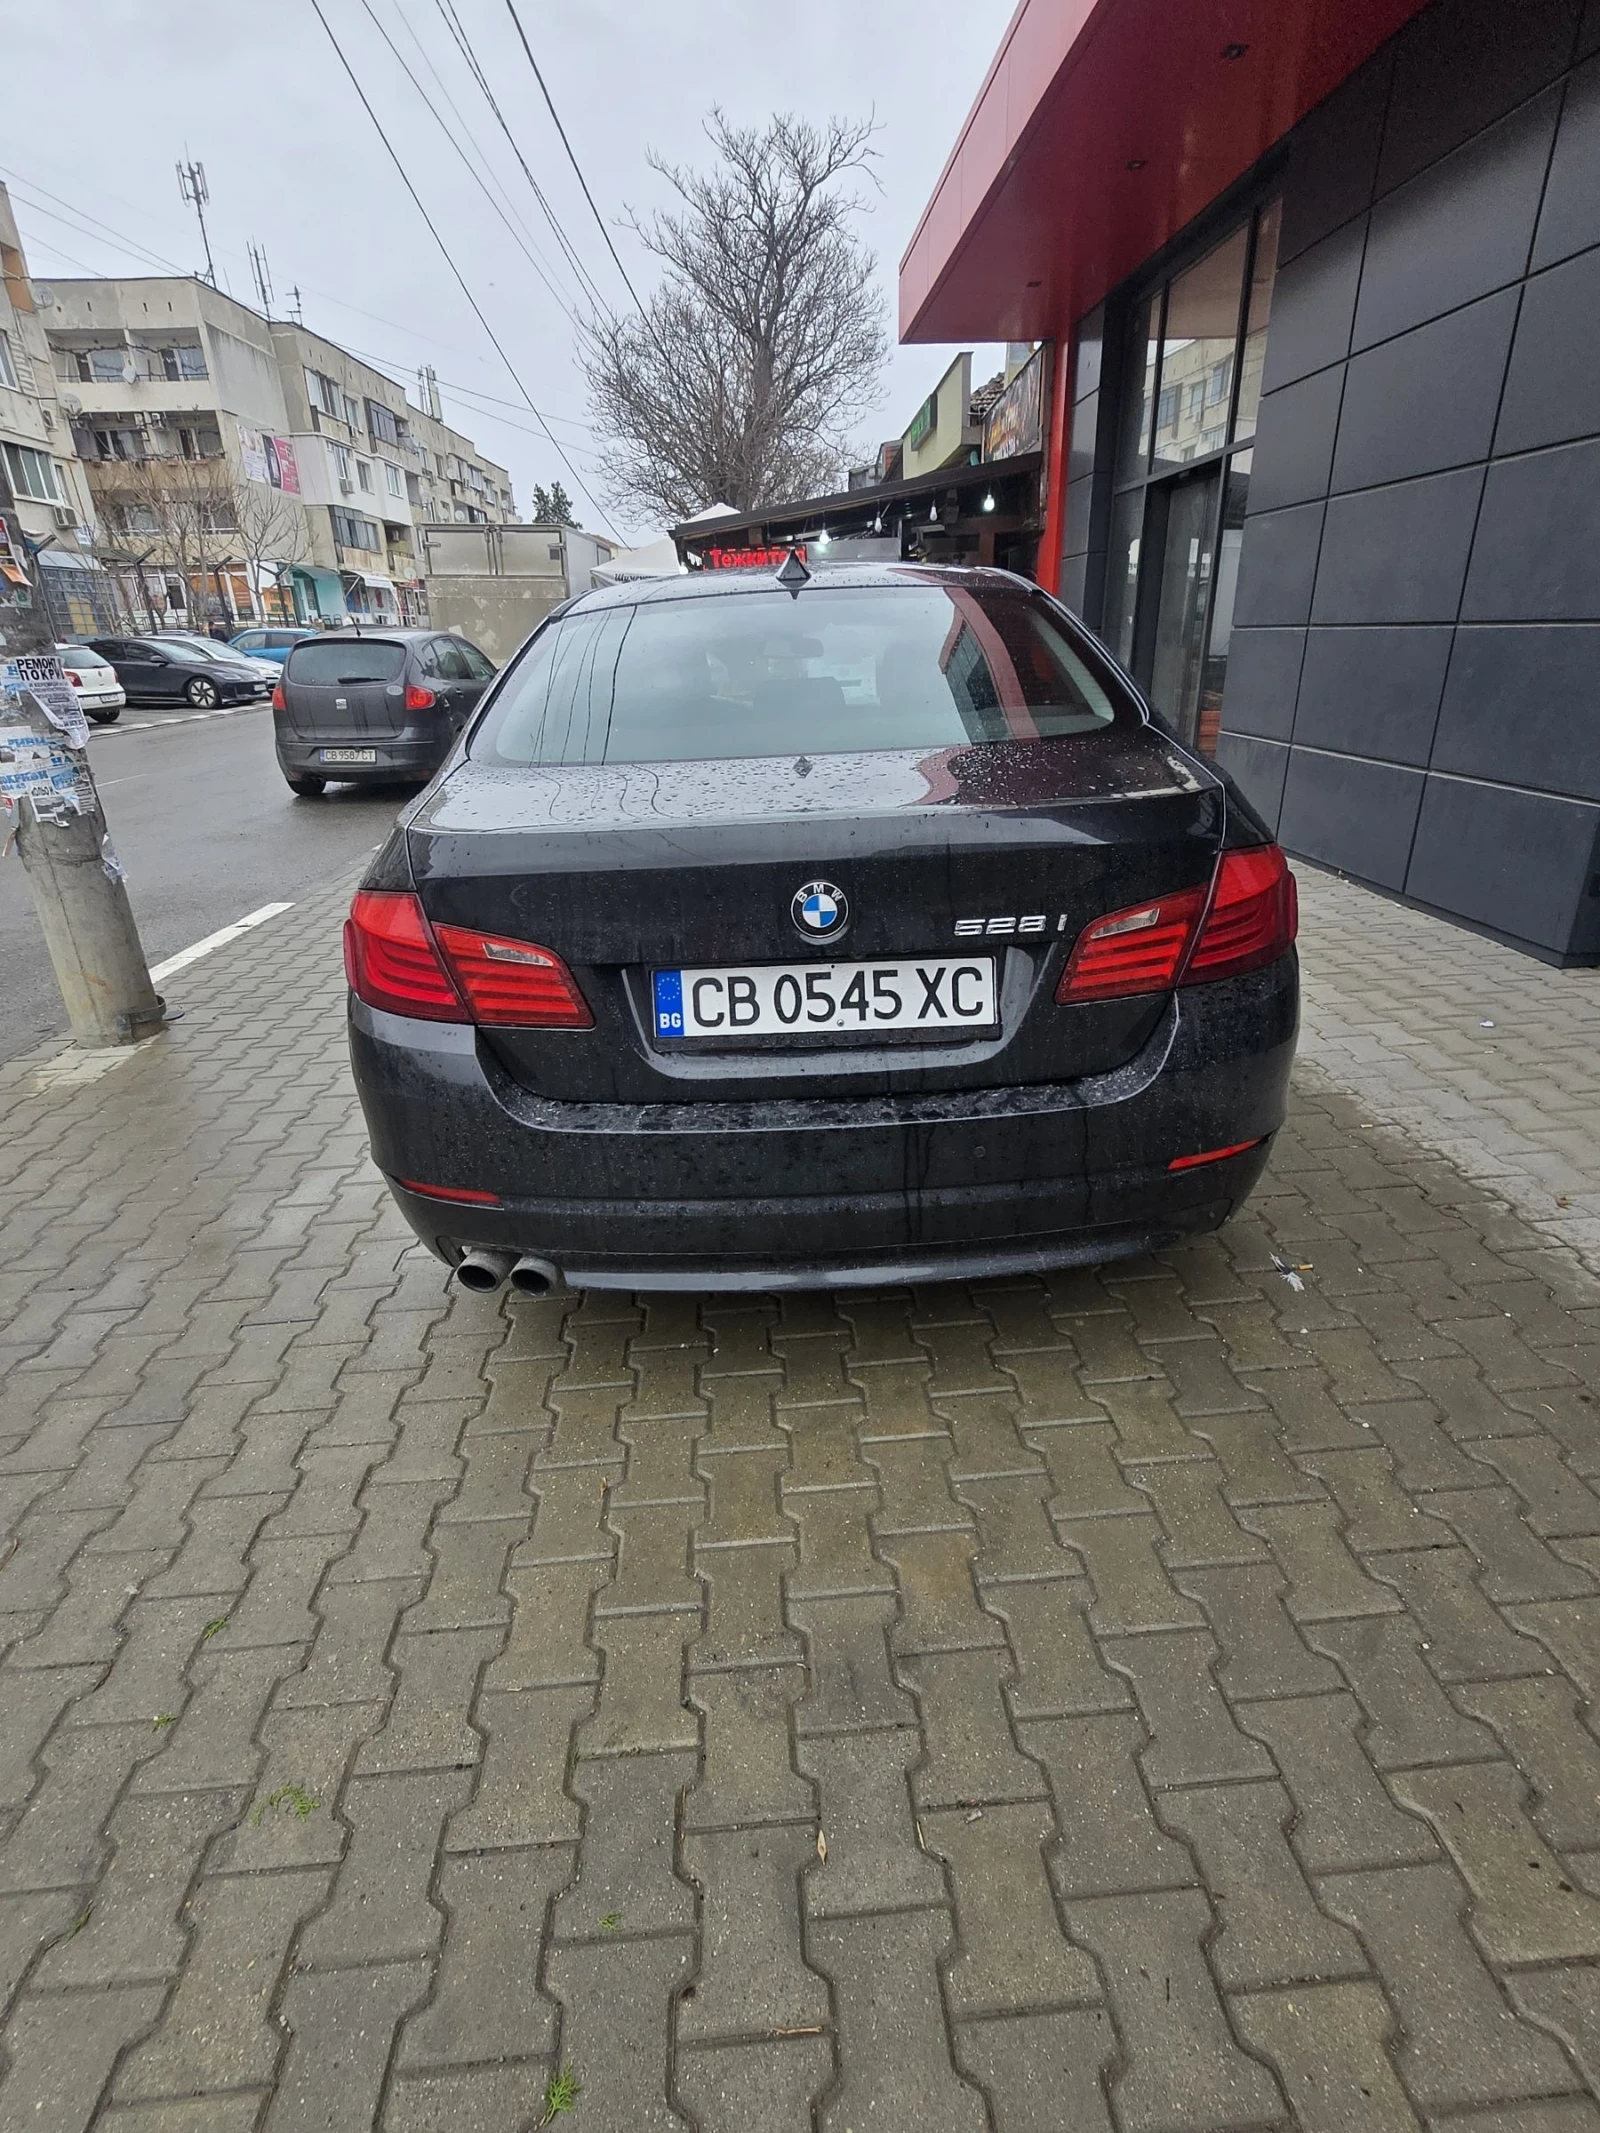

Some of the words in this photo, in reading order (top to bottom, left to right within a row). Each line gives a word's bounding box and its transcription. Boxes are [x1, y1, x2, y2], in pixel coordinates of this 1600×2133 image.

[16, 658, 58, 669] РЕМОНТ
[326, 751, 337, 759] CB
[339, 750, 360, 759] 9587
[362, 751, 373, 759] CT
[796, 884, 843, 903] BMW
[692, 976, 760, 1027] CB
[774, 970, 902, 1023] 0545
[916, 967, 983, 1019] XC
[660, 1013, 681, 1029] BG
